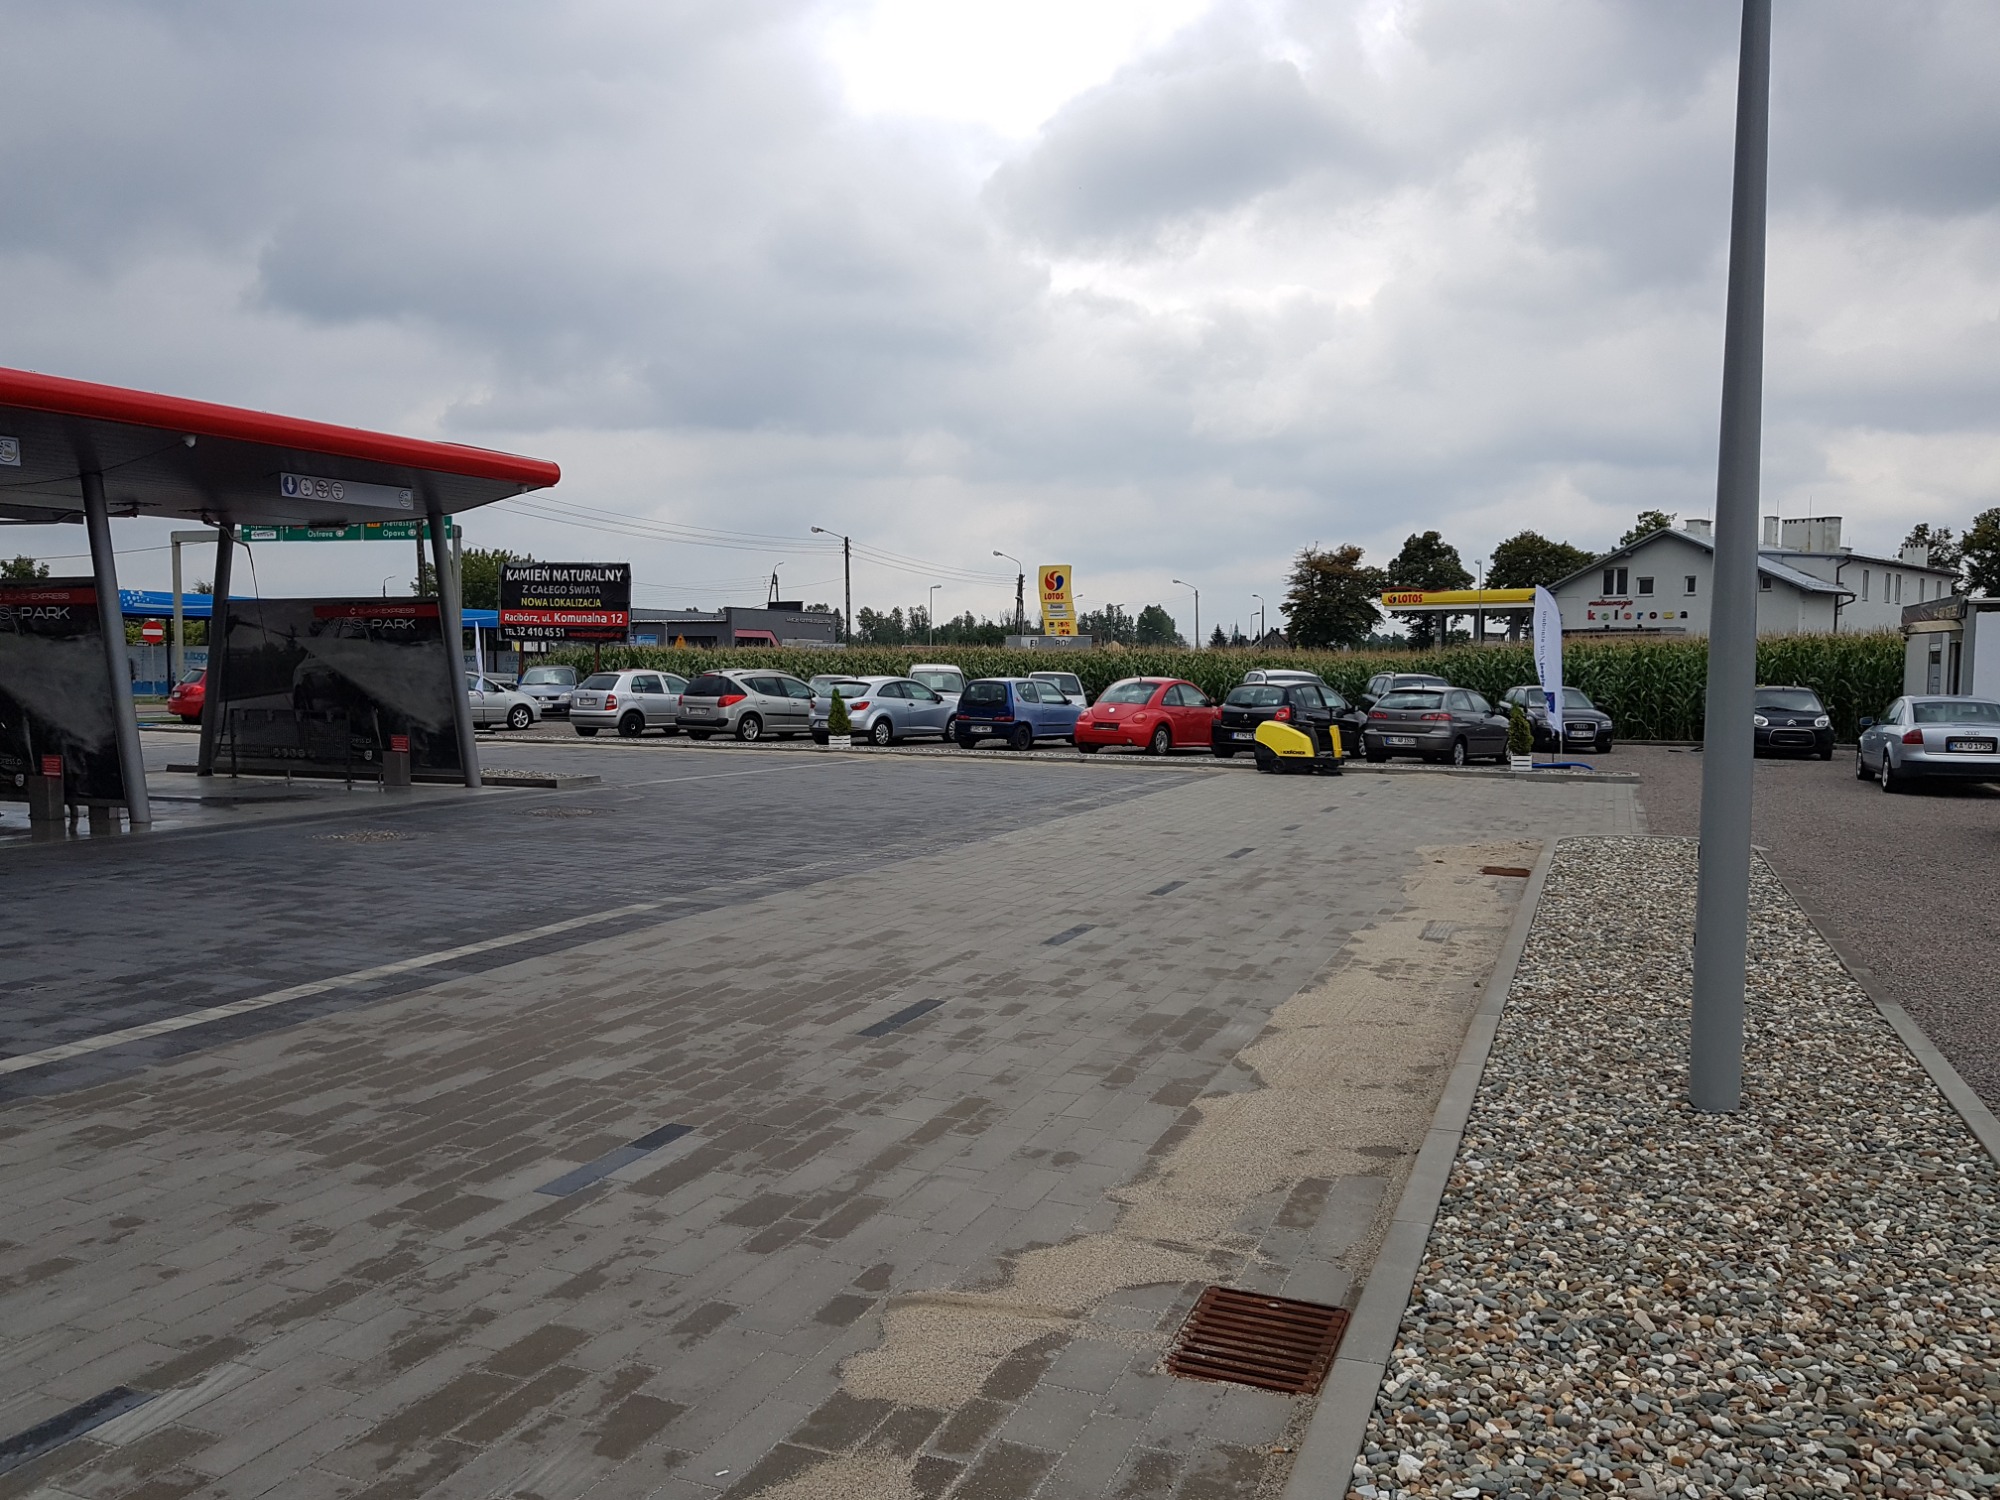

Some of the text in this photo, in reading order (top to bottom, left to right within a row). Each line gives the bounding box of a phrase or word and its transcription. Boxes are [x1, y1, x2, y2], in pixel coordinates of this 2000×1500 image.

[307, 529, 333, 538] Ostrava
[383, 529, 405, 539] Opava
[506, 566, 623, 582] KAMIEŃ NATURALNY
[522, 583, 601, 594] Z CAŁEGO ŚWIATA
[1044, 592, 1065, 600] LOTOS
[1397, 594, 1423, 604] LOTOS
[521, 597, 602, 608] NOWA LOKALIZACJA
[504, 613, 540, 623] Racibórz,
[554, 612, 607, 623] Komunalna
[610, 613, 623, 624] 12
[527, 628, 543, 637] 410
[544, 628, 554, 637] 45
[555, 628, 565, 637] 51
